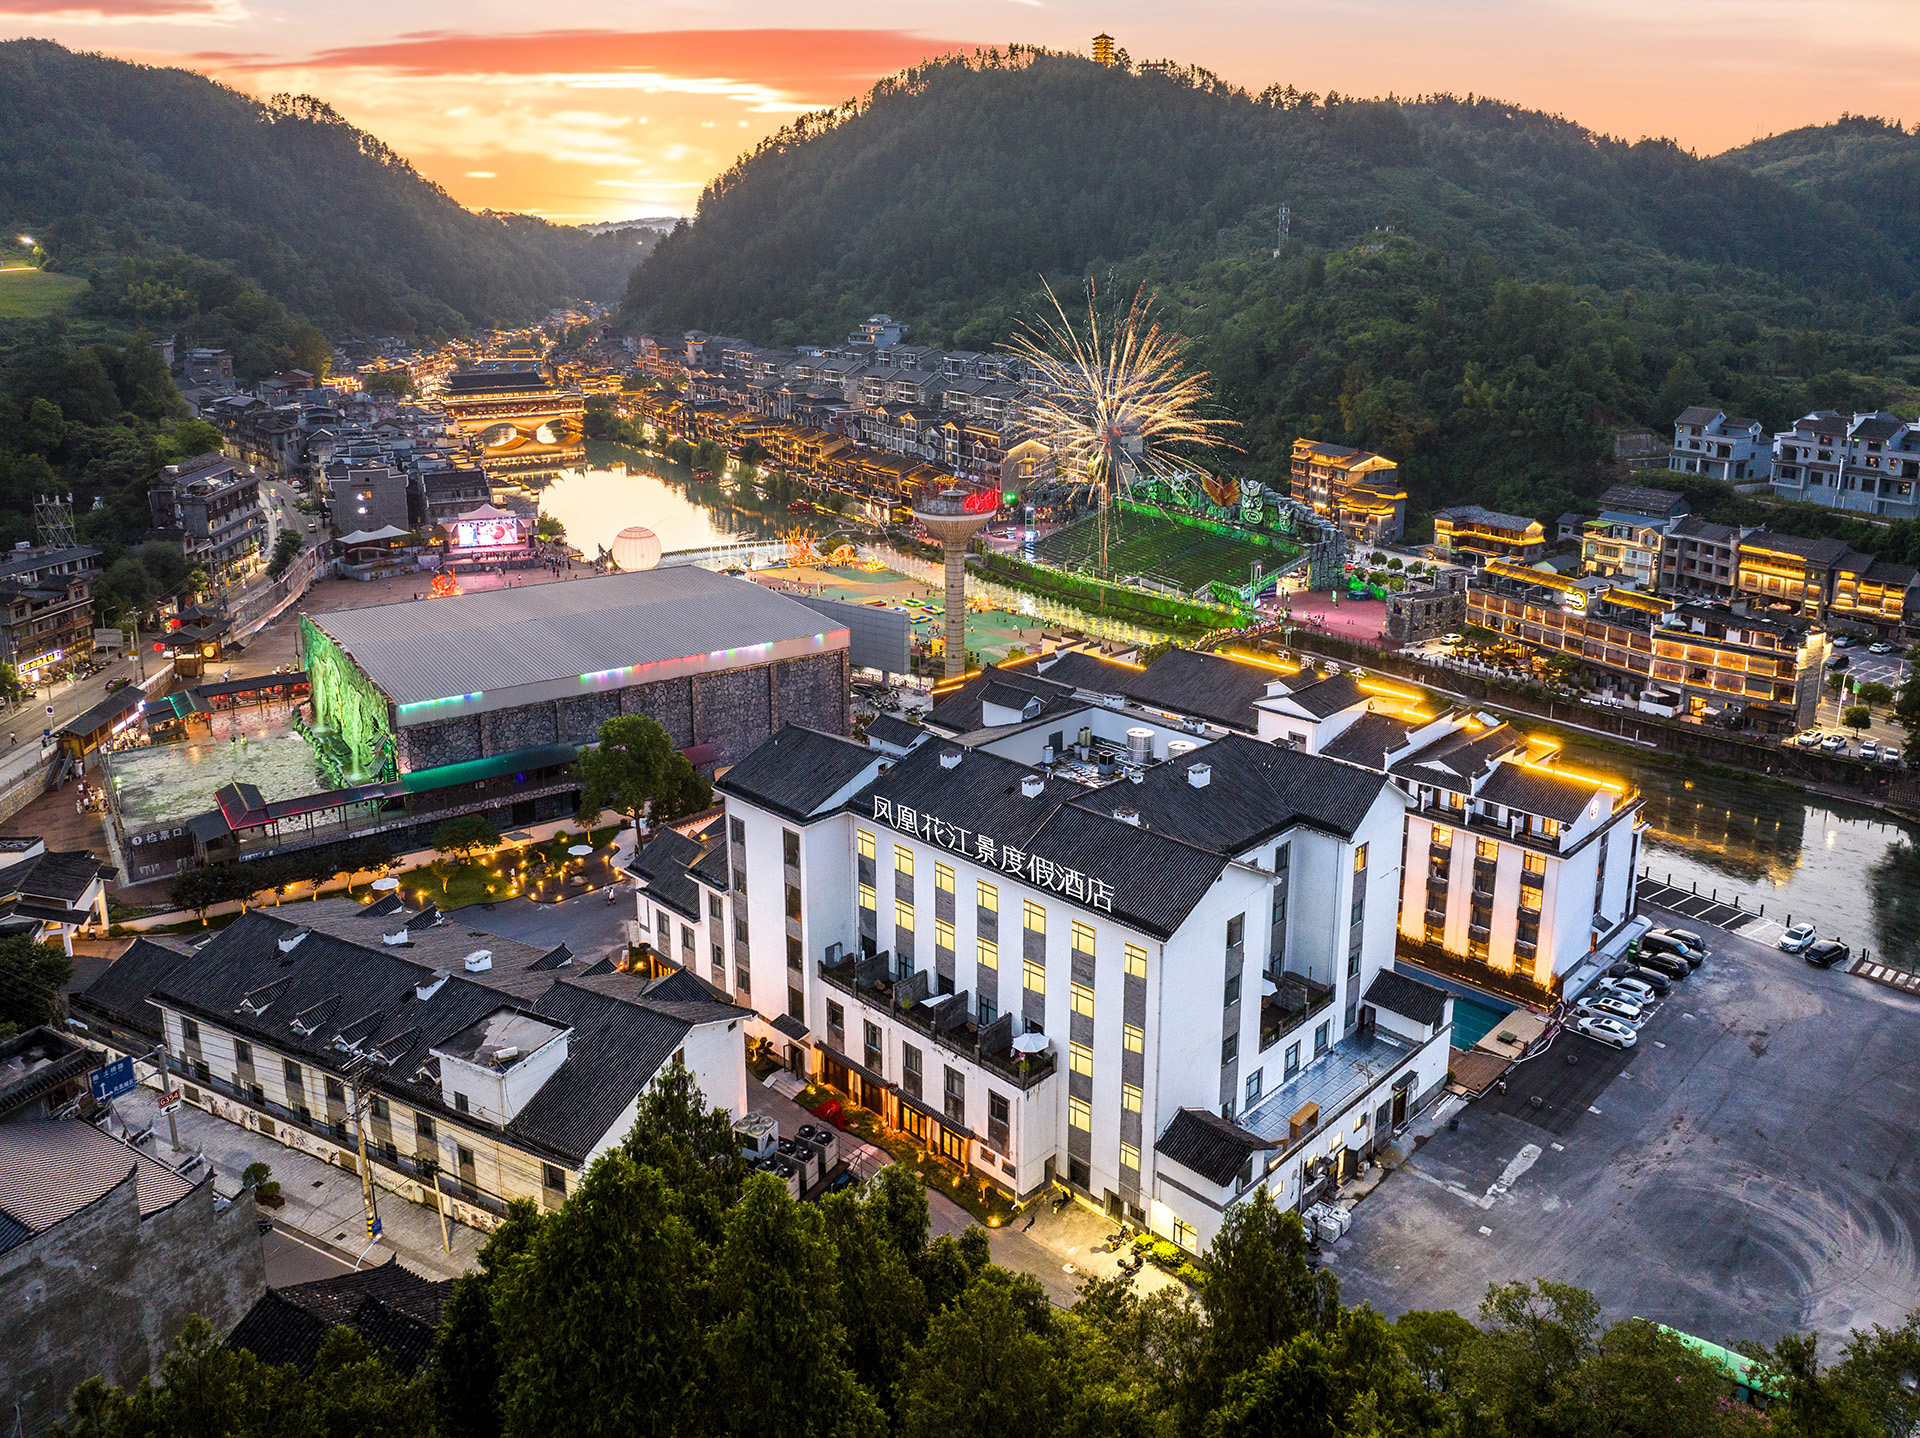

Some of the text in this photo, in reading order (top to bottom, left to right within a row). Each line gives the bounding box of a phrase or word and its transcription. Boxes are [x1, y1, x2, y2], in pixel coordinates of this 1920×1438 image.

[146, 827, 182, 843] 检票口
[872, 795, 1115, 914] 凤凰花江景度假酒店
[160, 1092, 179, 1106] G354
